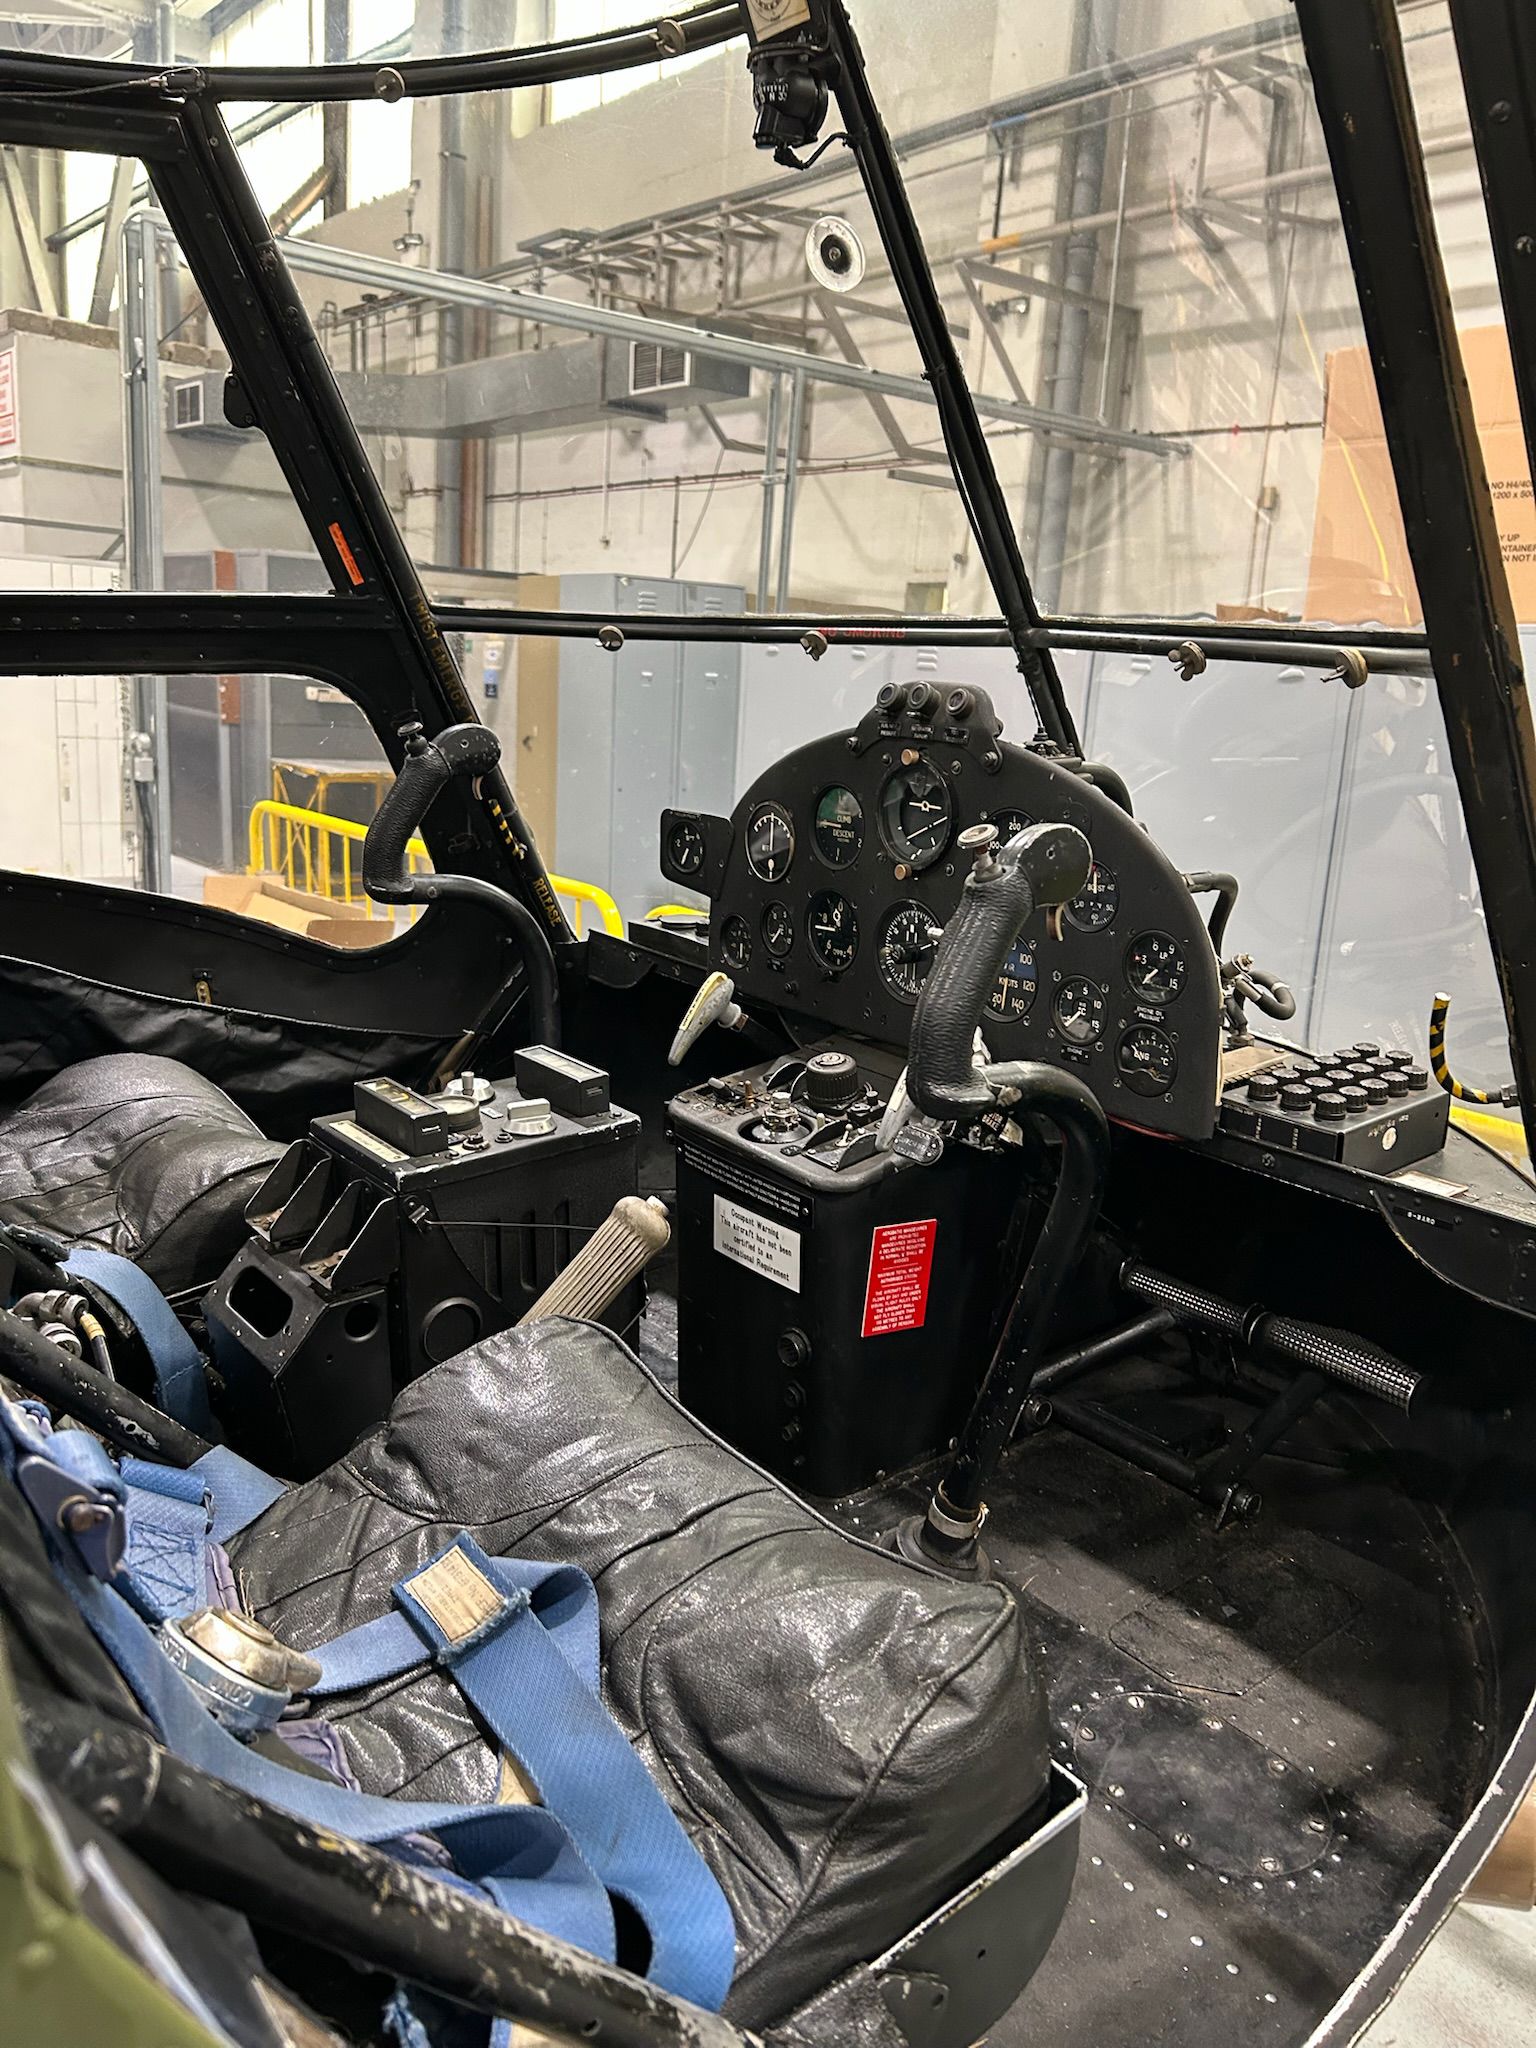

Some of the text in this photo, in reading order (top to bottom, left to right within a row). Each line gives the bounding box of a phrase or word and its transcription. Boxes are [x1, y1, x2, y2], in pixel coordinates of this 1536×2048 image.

[1507, 533, 1520, 542] UP
[1008, 821, 1022, 831] 200
[832, 828, 855, 838] DESCENT
[532, 877, 562, 928] RELEASE
[1152, 941, 1159, 951] 6
[1168, 944, 1175, 955] 9
[1019, 952, 1033, 966] 100
[1140, 954, 1147, 965] 3
[1022, 980, 1036, 993] 120
[1169, 978, 1178, 990] 15
[1011, 997, 1025, 1010] 140
[1093, 1000, 1102, 1009] 10
[720, 1214, 731, 1227] This
[732, 1223, 754, 1239] aircraft
[756, 1233, 766, 1245] has
[779, 1243, 792, 1257] been
[756, 1220, 780, 1240] Warning
[756, 1257, 790, 1282] Requirement
